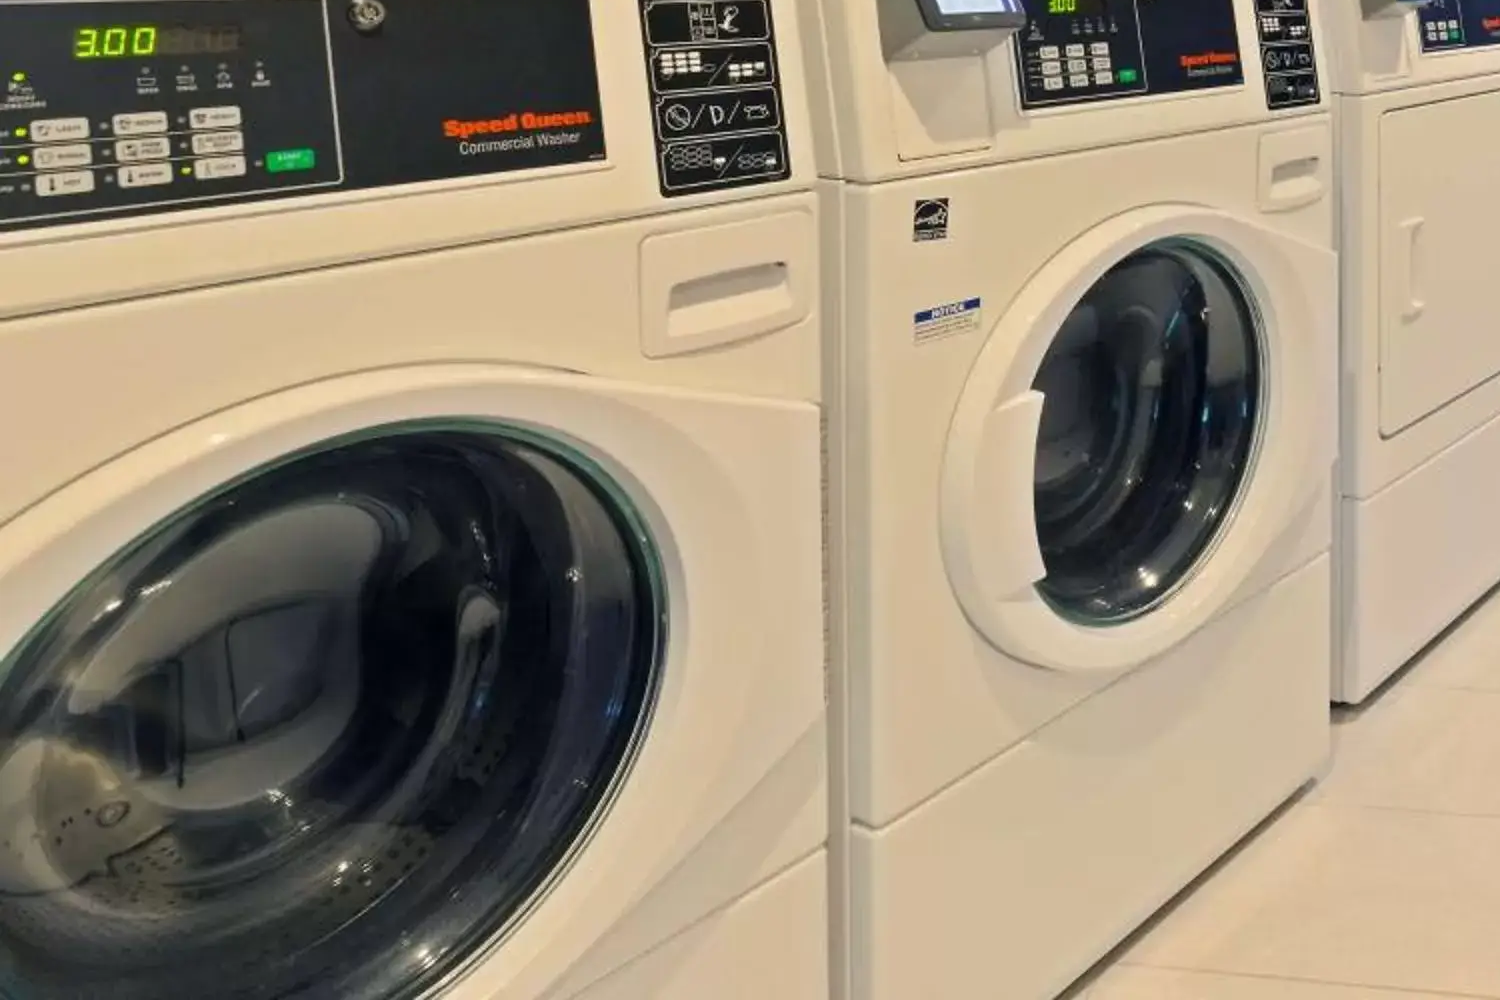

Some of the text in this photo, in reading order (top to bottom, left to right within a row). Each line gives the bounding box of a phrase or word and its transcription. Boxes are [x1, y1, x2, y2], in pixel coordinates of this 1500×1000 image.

[76, 27, 156, 57] 3.00
[443, 110, 592, 138] Speed Queen
[459, 131, 581, 155] Commercial Washer
